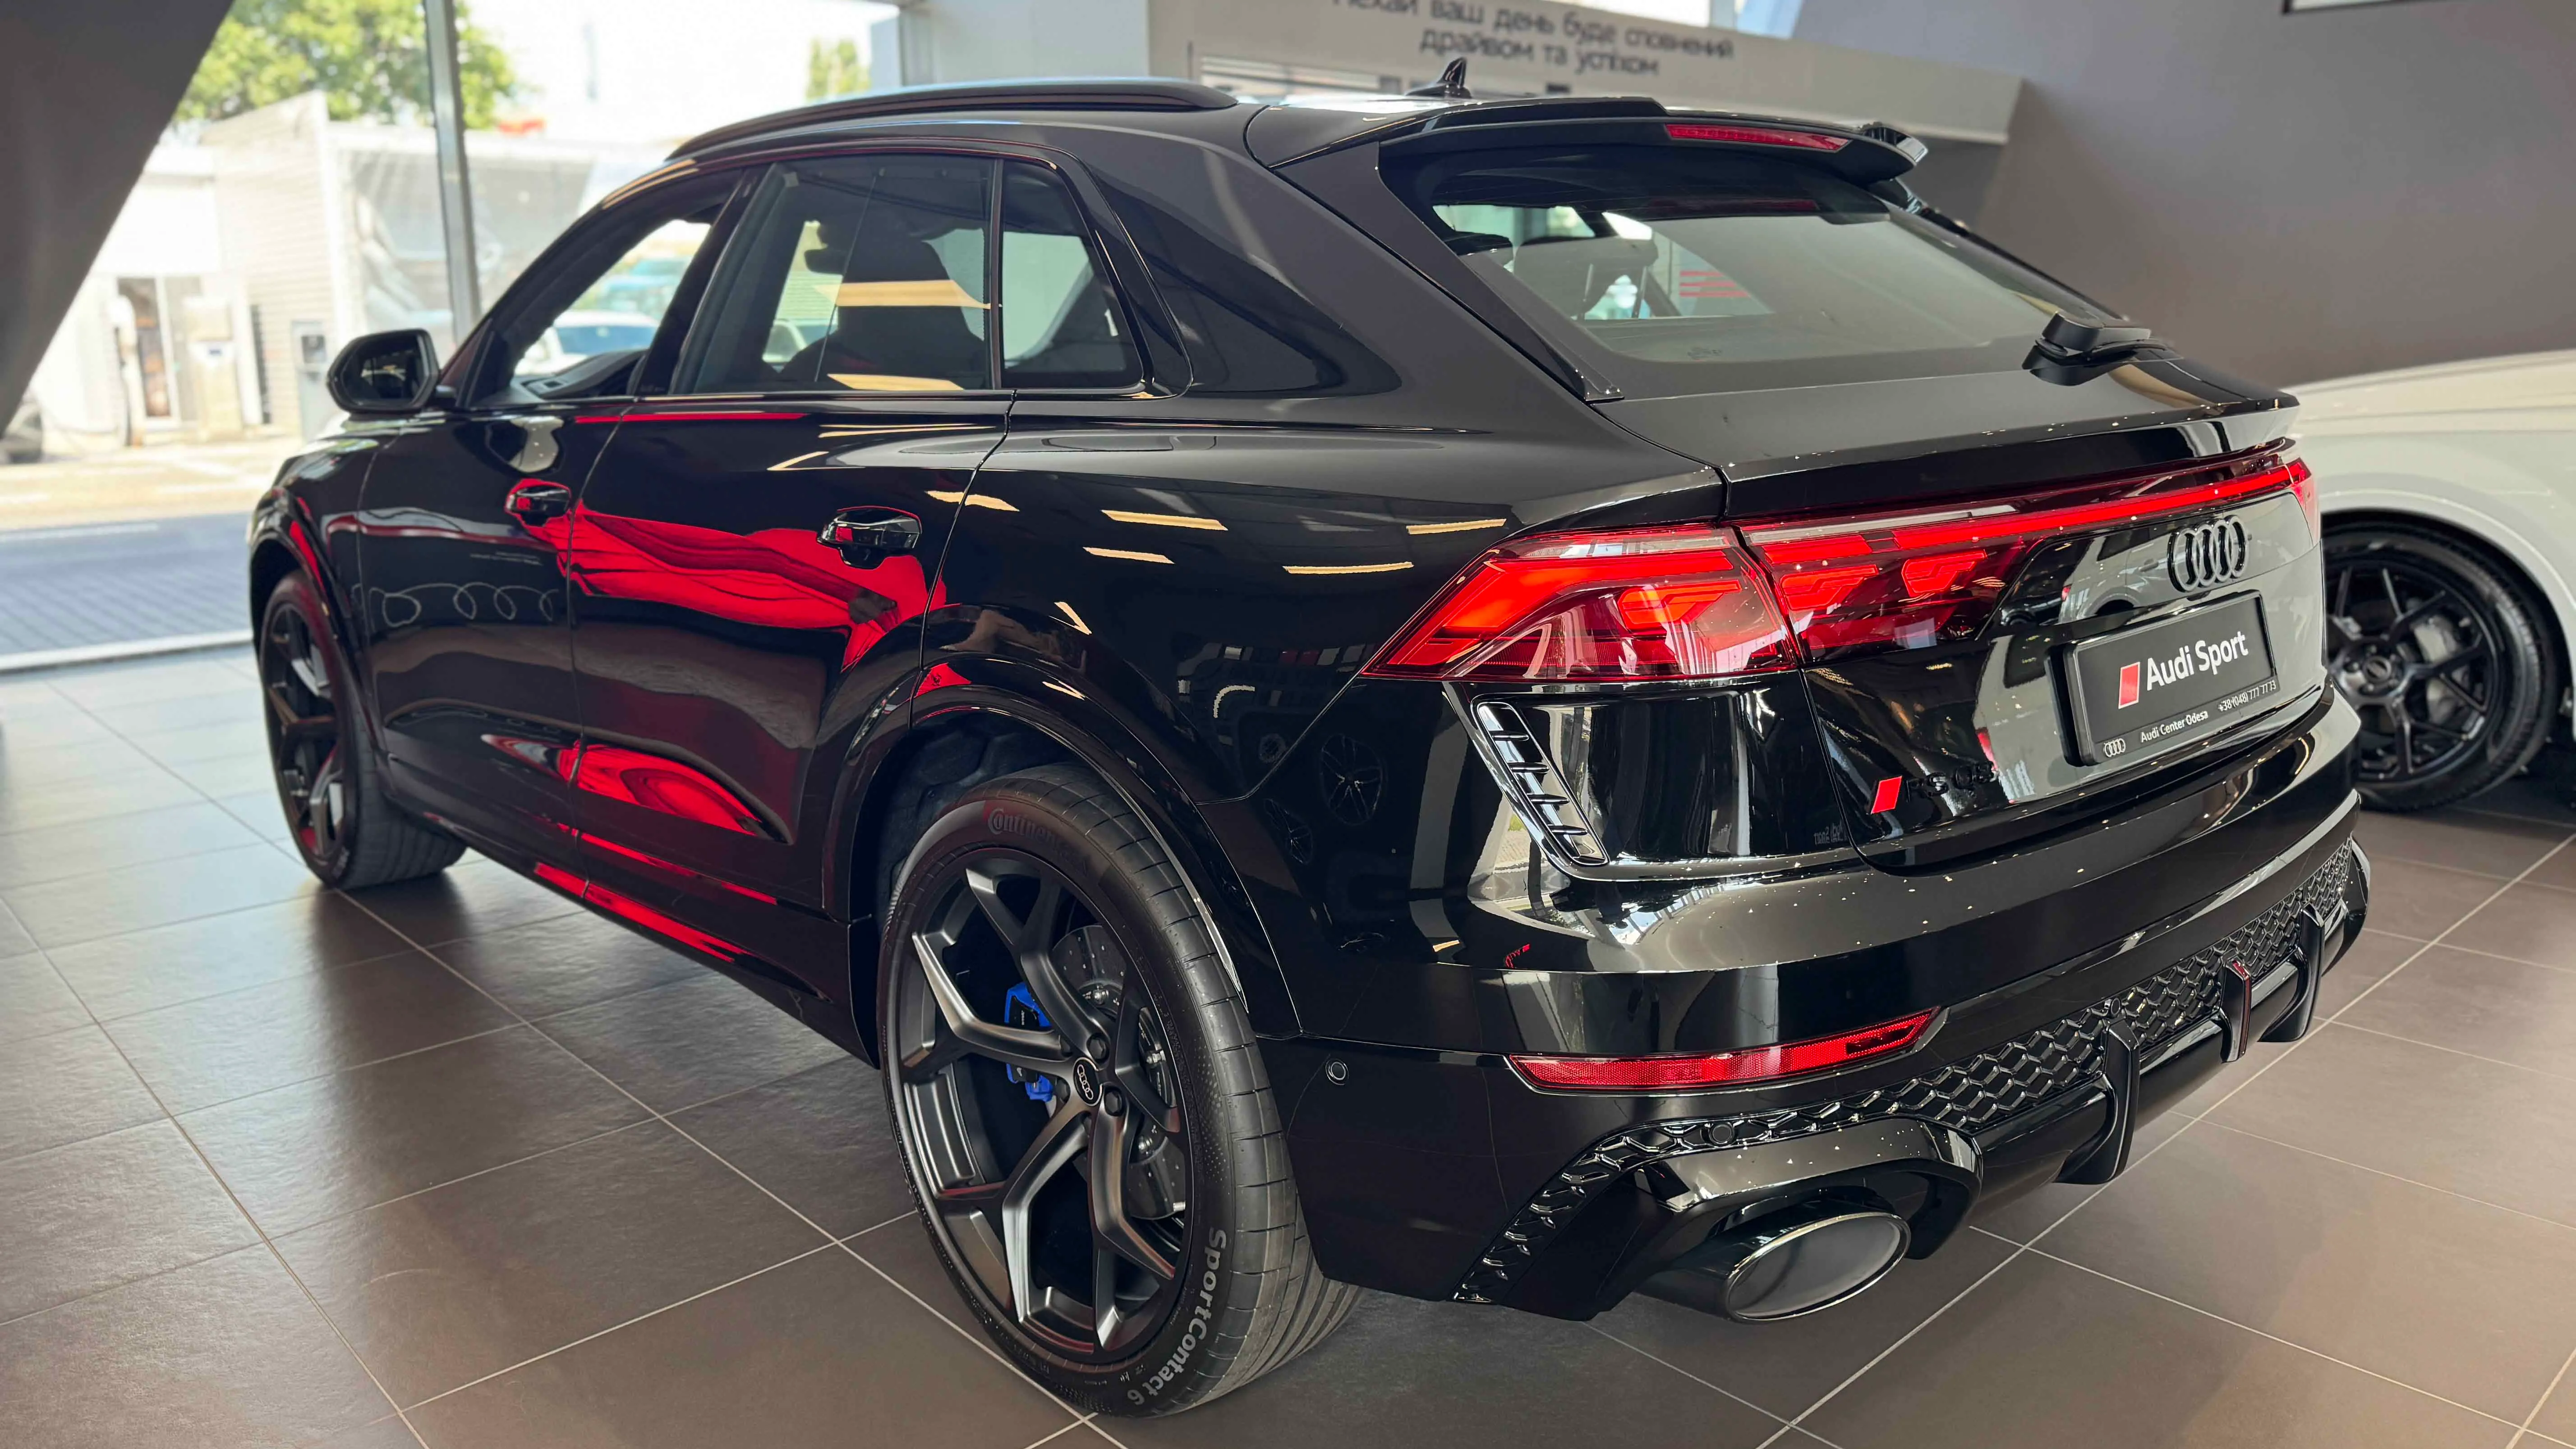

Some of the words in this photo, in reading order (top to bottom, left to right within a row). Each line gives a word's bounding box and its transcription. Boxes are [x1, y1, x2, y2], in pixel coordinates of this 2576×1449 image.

[1431, 1, 1484, 24] ваш
[1494, 9, 1554, 34] день
[1564, 11, 1617, 44] буде
[1421, 28, 1533, 60] драйвом
[1543, 44, 1568, 65] та
[1576, 48, 1659, 75] успіхом
[2147, 645, 2195, 691] Audi
[2195, 631, 2249, 675] Sport
[2140, 727, 2159, 743] Audi
[2160, 718, 2185, 736] Center
[2185, 710, 2208, 726] Odesa
[988, 807, 1088, 877] Continen
[1142, 1227, 1226, 1396] SportContact
[1127, 1389, 1145, 1405] 6
